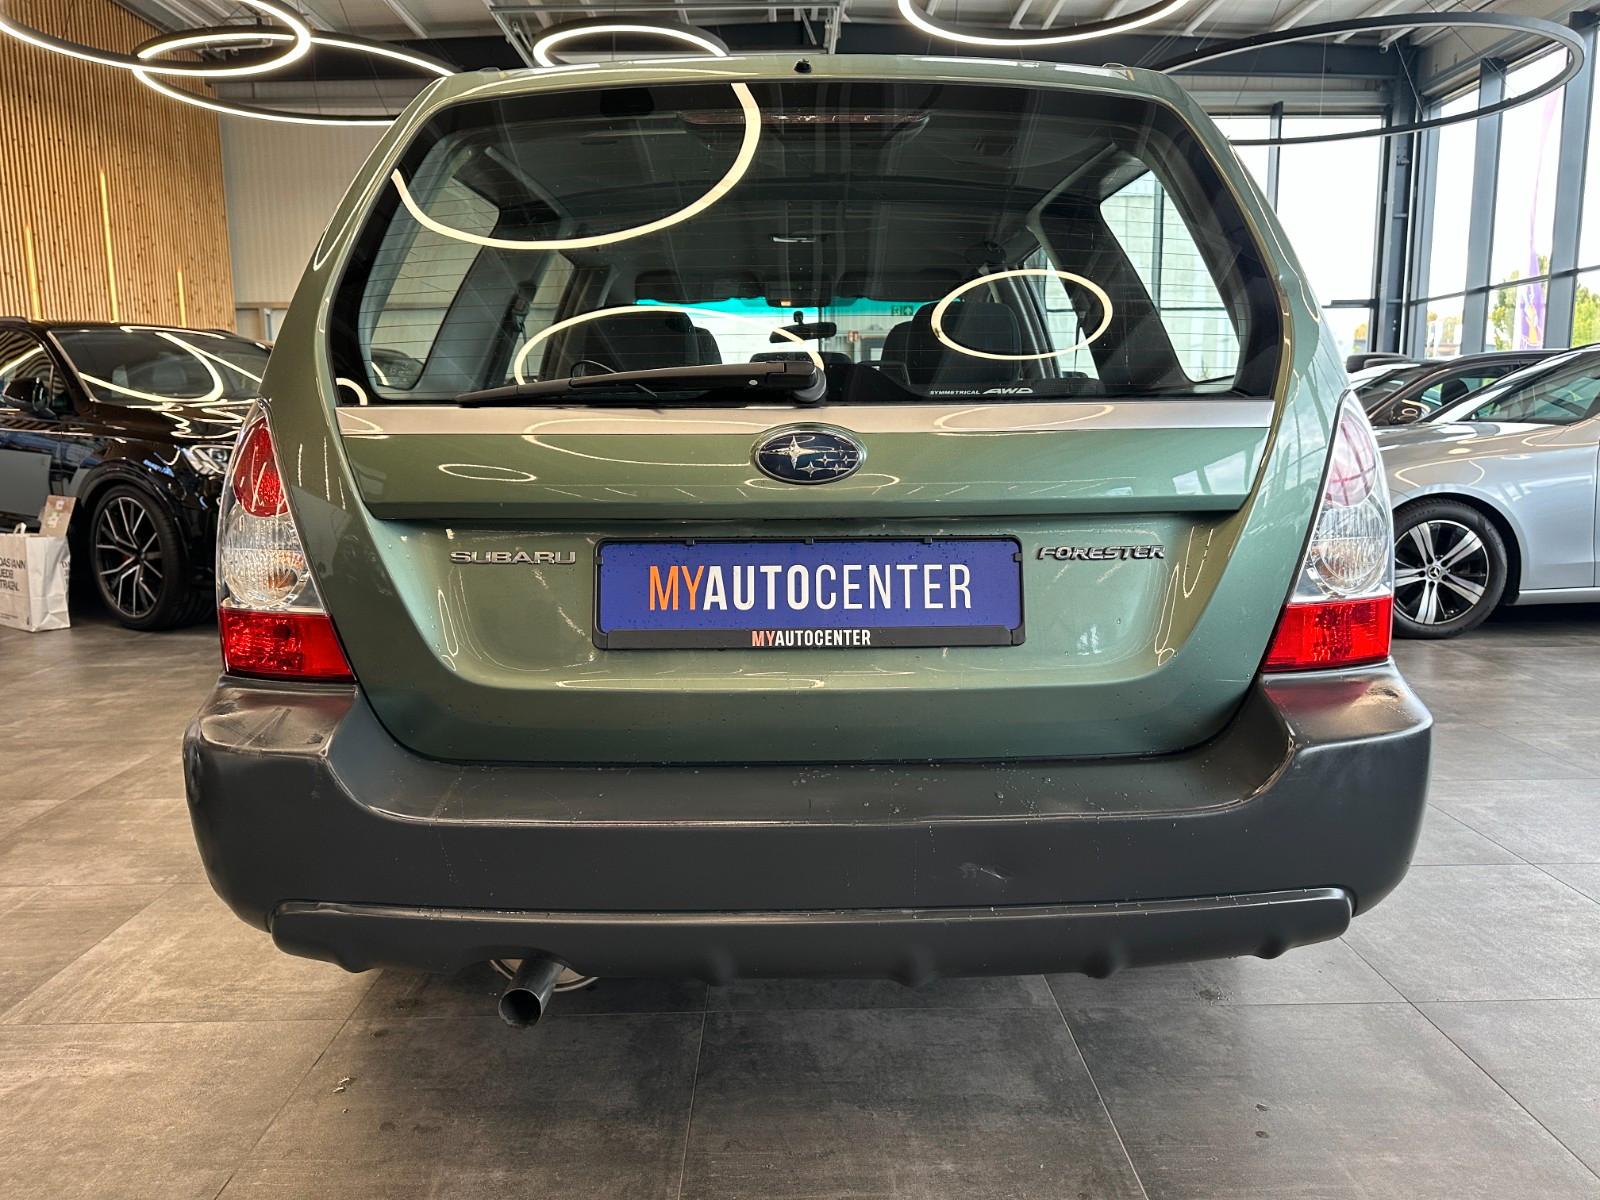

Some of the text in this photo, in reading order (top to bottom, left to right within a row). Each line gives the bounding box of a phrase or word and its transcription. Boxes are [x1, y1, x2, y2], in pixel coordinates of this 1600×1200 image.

[450, 551, 577, 564] SUBARU
[1036, 545, 1166, 560] FORESTER
[648, 563, 973, 612] MYAUTOCENTER
[751, 629, 872, 647] MYAUTOCENTER
